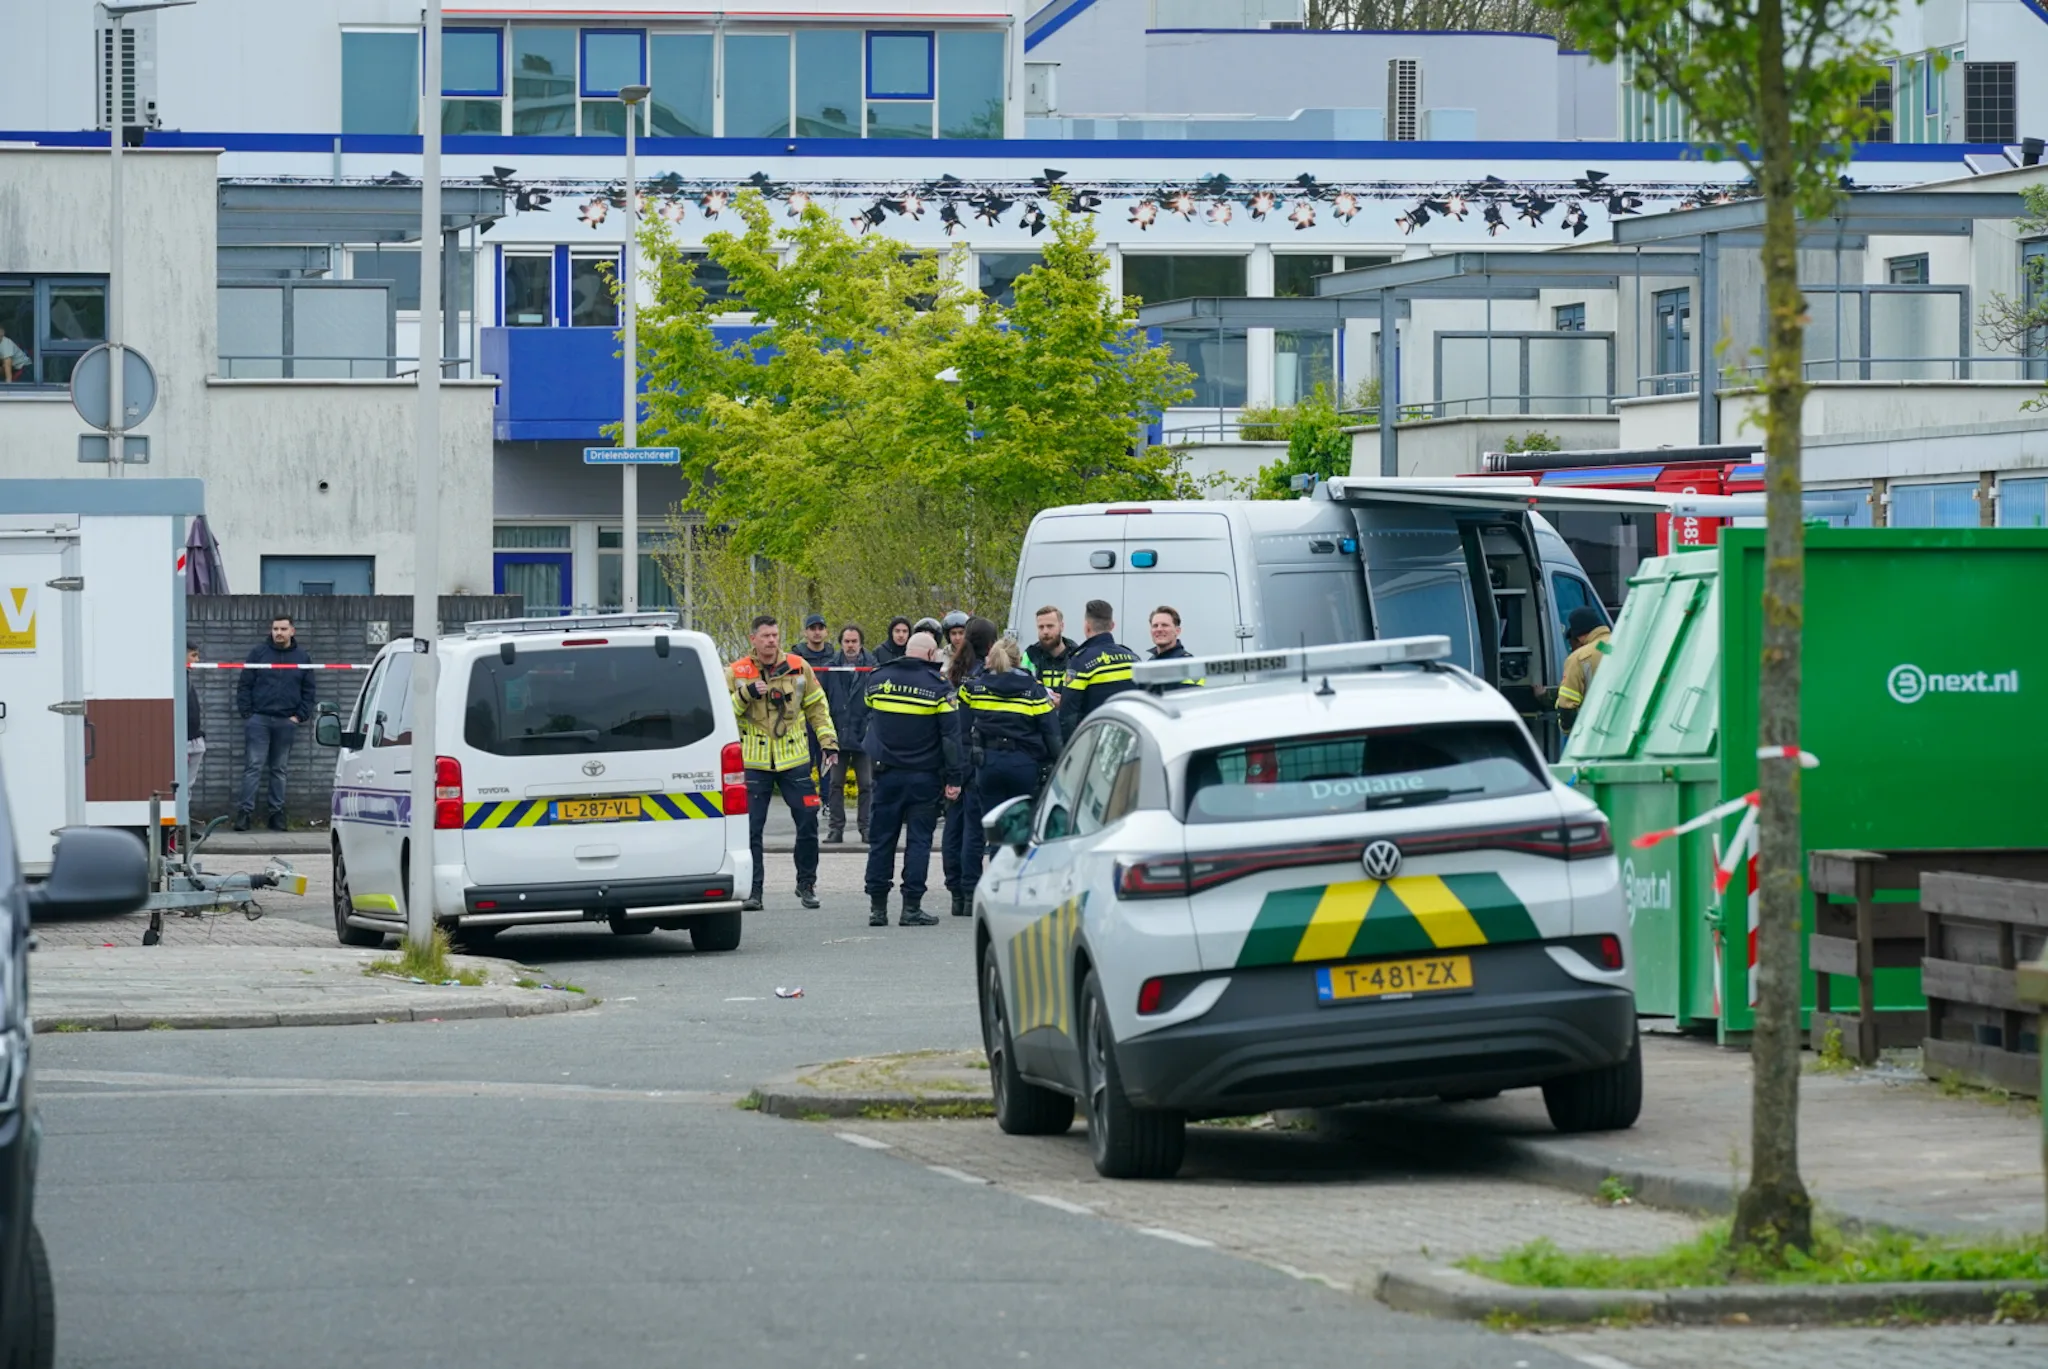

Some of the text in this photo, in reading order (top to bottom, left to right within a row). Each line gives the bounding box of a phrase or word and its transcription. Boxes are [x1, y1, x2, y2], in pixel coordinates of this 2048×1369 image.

[671, 770, 714, 780] PROACE
[477, 786, 510, 795] TOYOTA
[1310, 775, 1424, 800] Douane
[564, 801, 633, 818] L-287-VL
[1344, 961, 1458, 992] T-481-ZX
